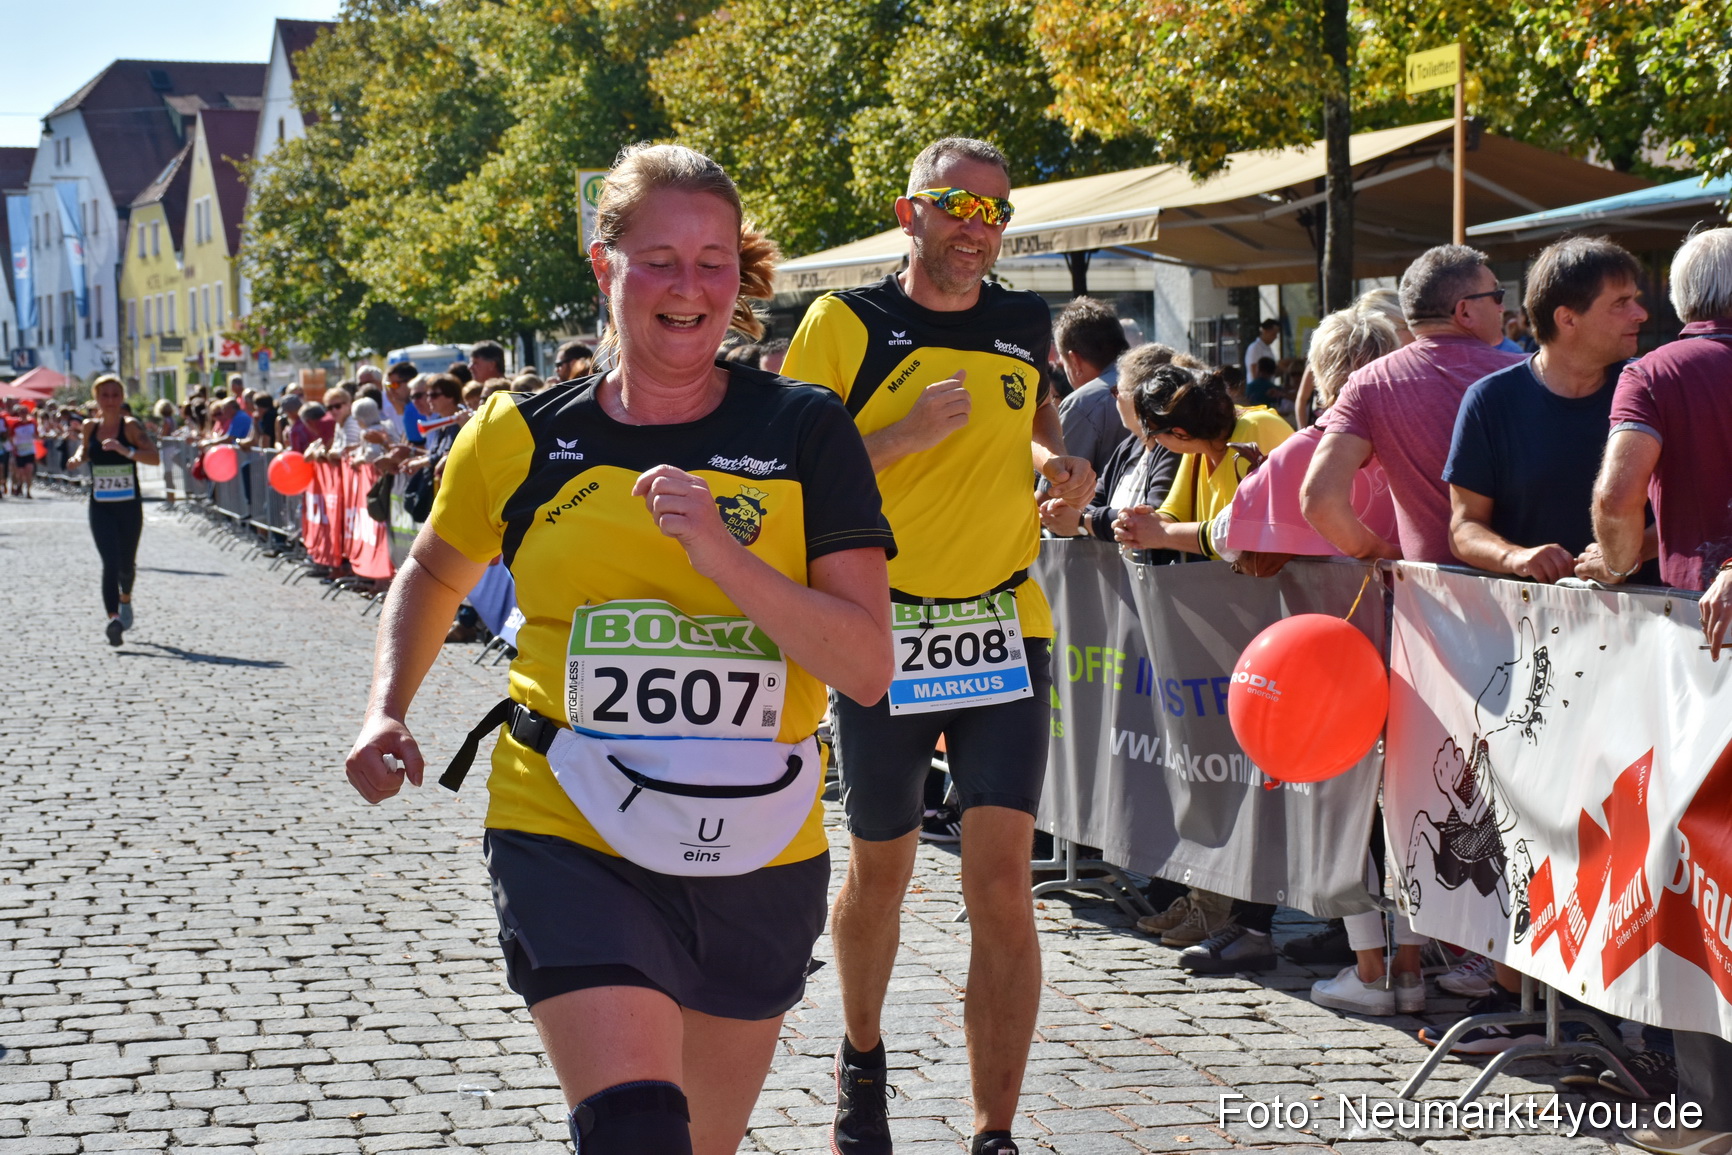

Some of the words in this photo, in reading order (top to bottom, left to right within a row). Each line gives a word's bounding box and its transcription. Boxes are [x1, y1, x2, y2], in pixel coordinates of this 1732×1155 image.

[1417, 60, 1457, 79] Toiletten
[888, 338, 913, 346] erima
[887, 359, 921, 393] Markus
[549, 449, 584, 460] erima
[99, 477, 129, 489] 2743
[738, 507, 758, 518] TSV
[727, 517, 757, 532] BURG-
[585, 608, 766, 655] BOCK
[1008, 629, 1015, 637] B
[900, 629, 1009, 672] 2608
[767, 677, 776, 687] D
[913, 675, 1005, 699] MARKUS
[593, 666, 760, 727] 2607
[1247, 687, 1280, 702] energie
[698, 818, 724, 842] U
[683, 850, 721, 862] eins
[1615, 928, 1632, 949] Sicher
[1629, 921, 1640, 934] ist
[1640, 905, 1658, 927] sicher
[1703, 928, 1724, 963] Sicher
